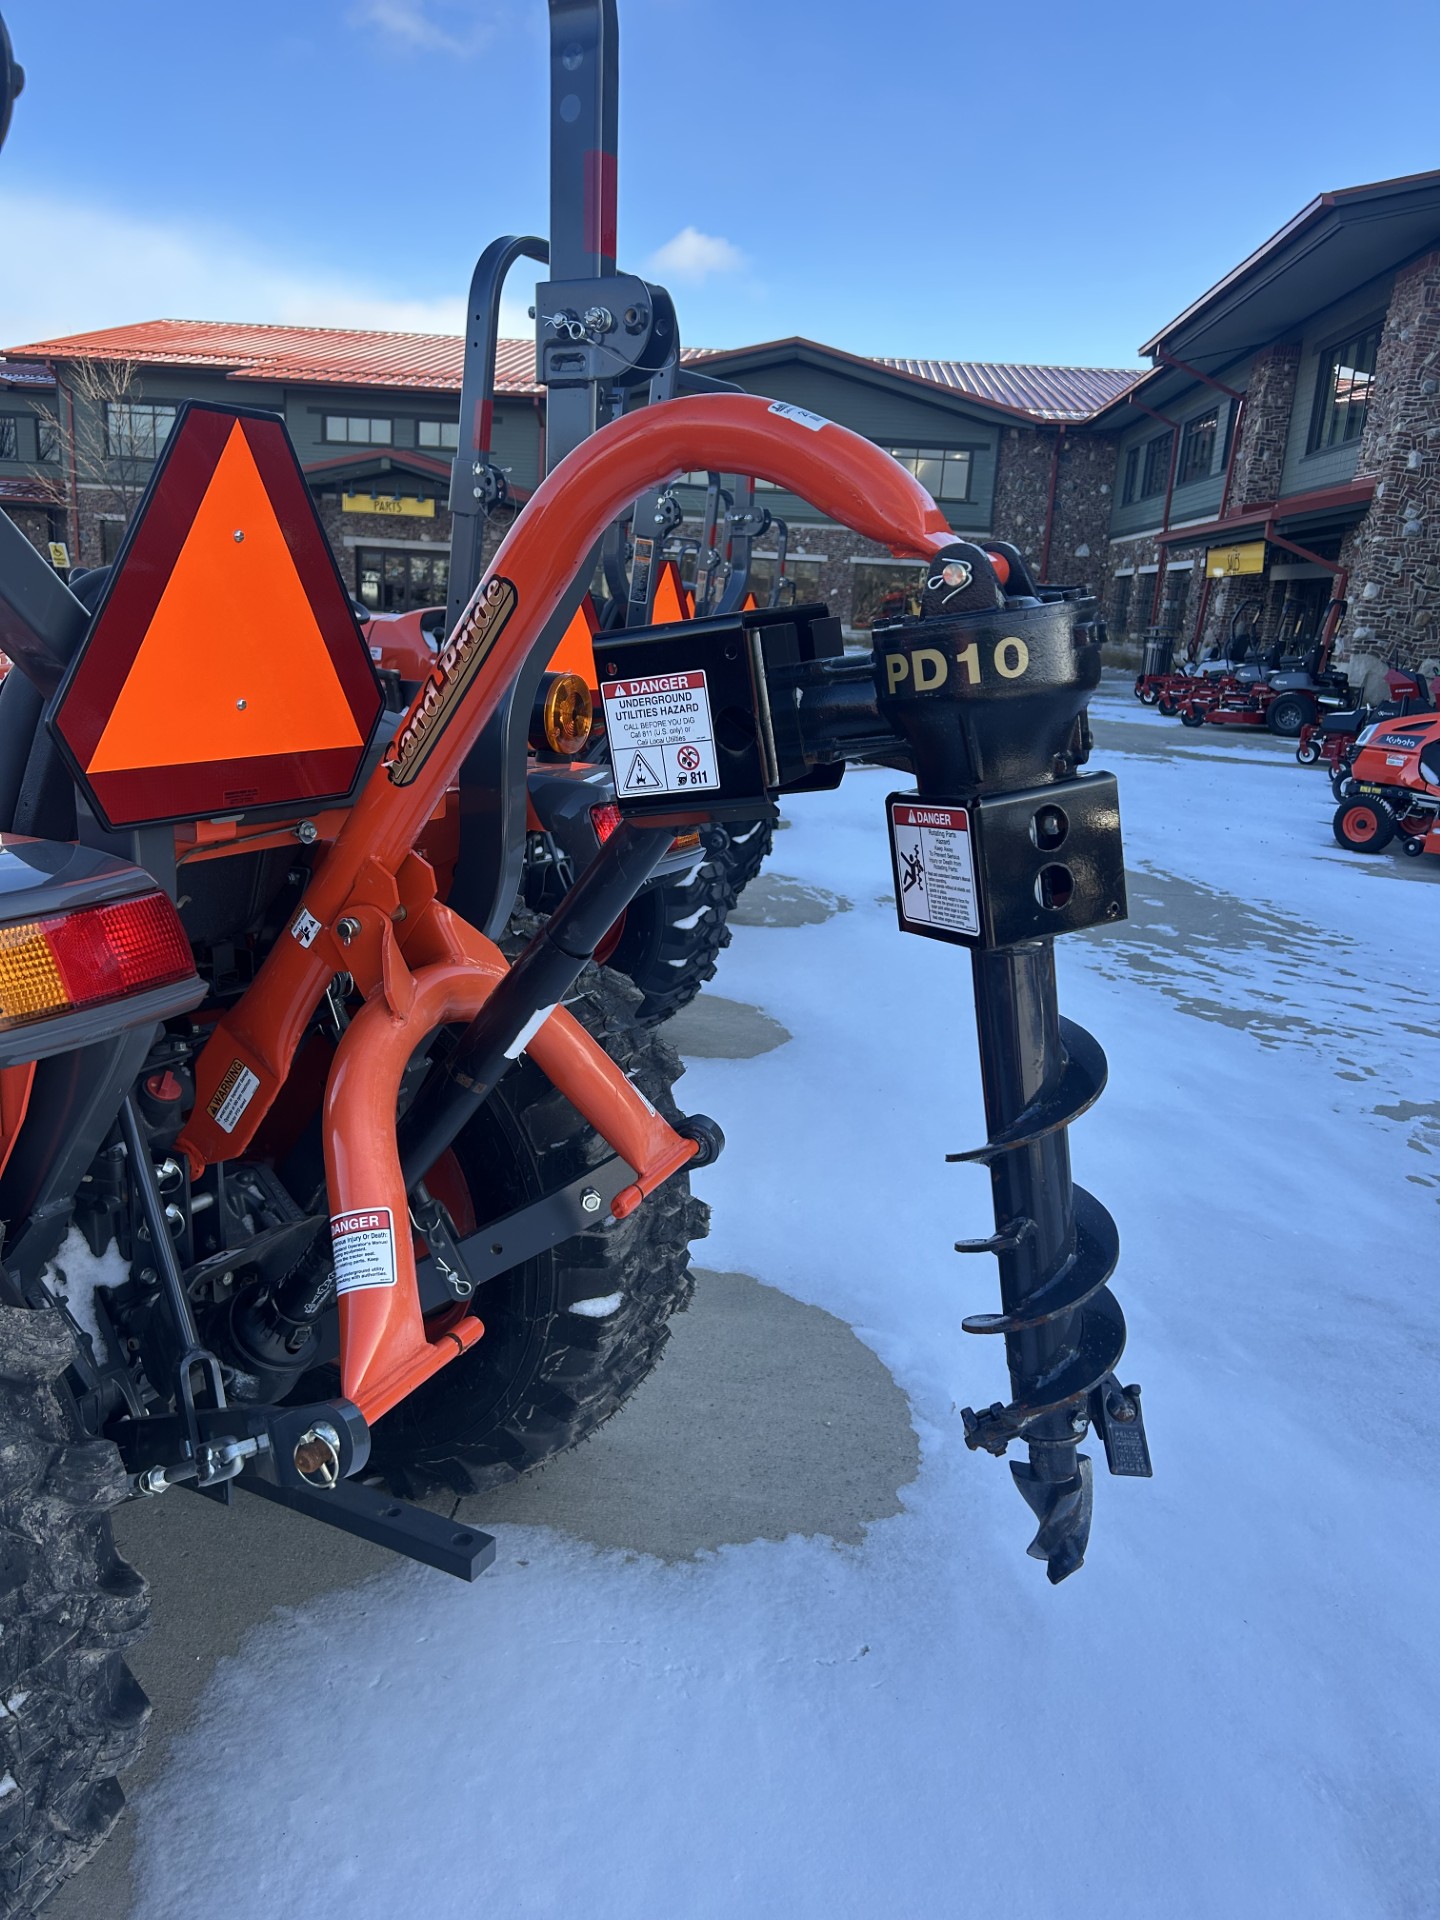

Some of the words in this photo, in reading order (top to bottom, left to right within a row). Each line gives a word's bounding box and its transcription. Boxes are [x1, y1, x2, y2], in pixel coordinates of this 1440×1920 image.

[374, 501, 402, 512] PARTS
[886, 637, 1029, 694] PD10
[382, 680, 444, 779] Land
[438, 578, 505, 685] Pride
[630, 677, 688, 695] DANGER
[619, 692, 692, 709] UNDERGROUND
[615, 708, 658, 721] UTILITIES
[660, 703, 699, 715] HAZARD
[624, 722, 639, 731] CALL
[640, 720, 666, 728] BEFORE
[668, 718, 682, 726] YOU
[630, 730, 641, 738] Call
[642, 729, 653, 737] 811
[669, 727, 683, 735] only)
[650, 737, 665, 745] Local
[1386, 736, 1415, 746] Kubota
[690, 771, 708, 784] 811
[917, 812, 951, 825] DANGER
[213, 1061, 242, 1105] WARNING
